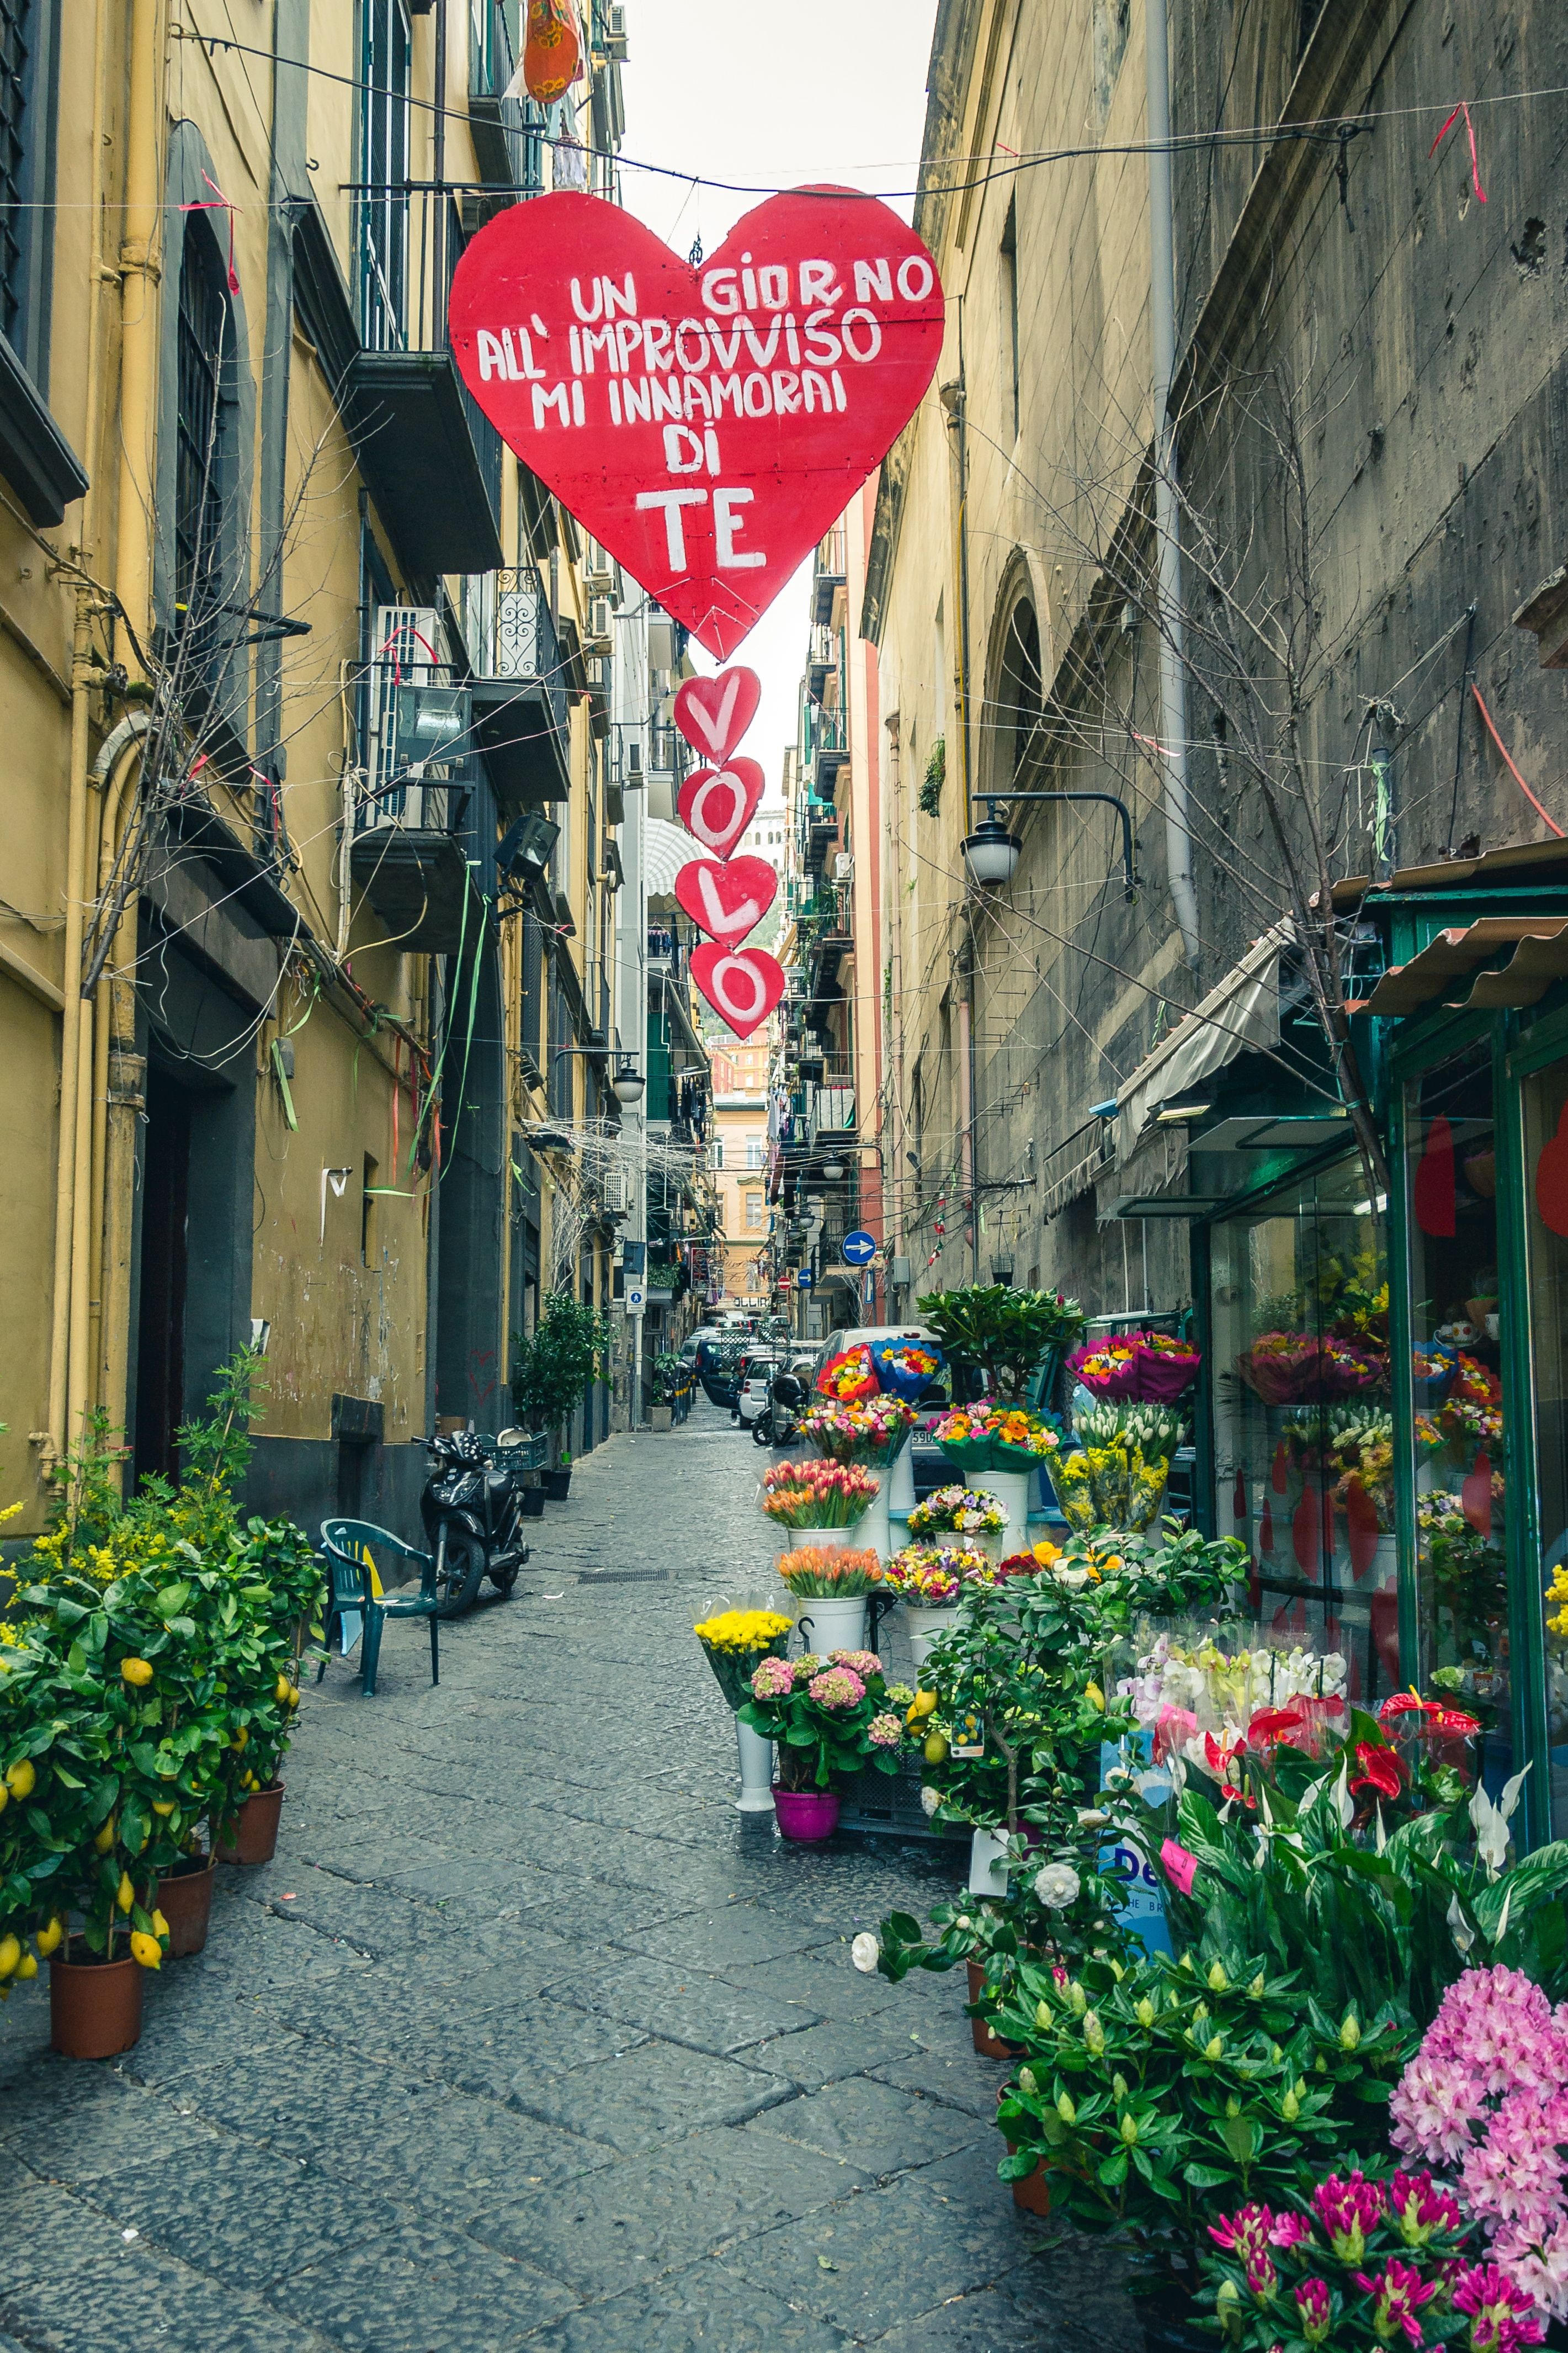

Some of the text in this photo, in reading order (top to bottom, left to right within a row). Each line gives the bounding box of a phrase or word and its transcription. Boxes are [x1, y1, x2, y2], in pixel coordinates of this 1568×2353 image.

[570, 272, 637, 322] UN
[569, 307, 883, 374] IMPROVVISO
[531, 369, 847, 430] MI INNAMORAI
[636, 487, 767, 573] TE
[913, 1432, 936, 1443] 59D
[1128, 1899, 1139, 1909] HE
